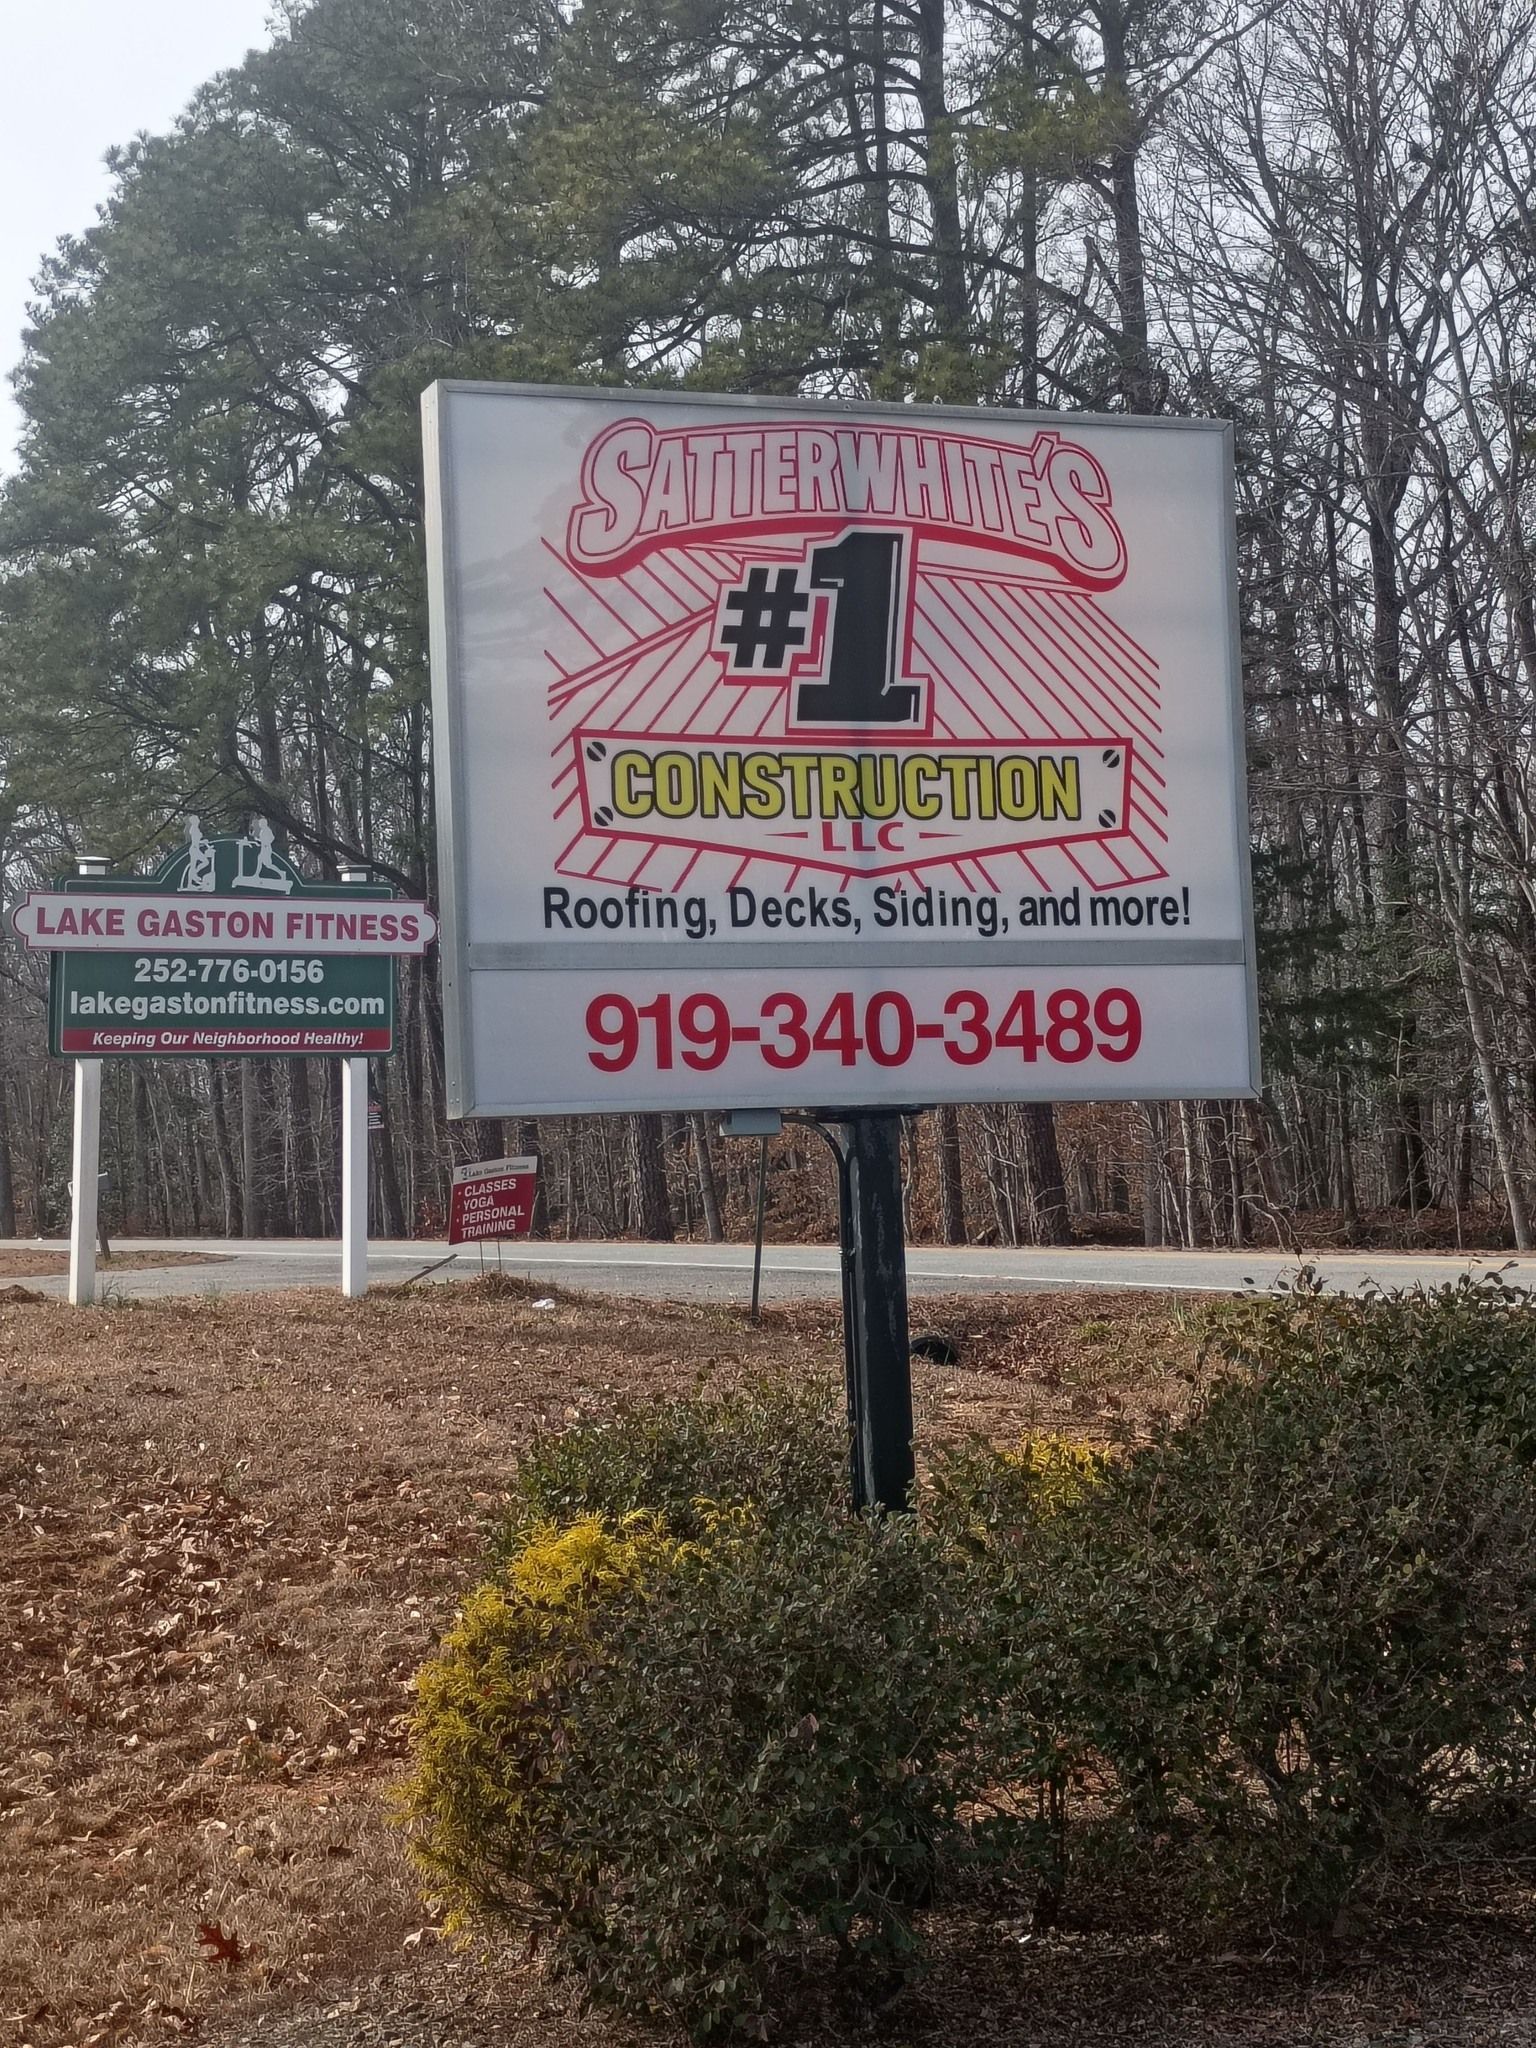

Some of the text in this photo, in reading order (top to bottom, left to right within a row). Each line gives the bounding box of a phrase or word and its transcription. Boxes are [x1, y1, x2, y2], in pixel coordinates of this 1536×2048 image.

[570, 418, 1126, 586] SATTERWHITE'S
[718, 530, 923, 724] #1
[611, 751, 1082, 821] CONSTRUCTION
[821, 821, 905, 853] LLC
[36, 907, 420, 941] LAKE GASTON FITNESS
[543, 884, 1192, 939] Roofing, Decks, Siding, and more!
[134, 958, 325, 983] 252-776-0156
[69, 990, 386, 1021] lakegastonfitness.com
[92, 1031, 364, 1048] Keeping Our Neighborhood Healthy!
[584, 988, 1144, 1073] 919-340-3489
[465, 1178, 516, 1197] CLASSES
[462, 1205, 525, 1225] PERSONAL
[463, 1196, 494, 1211] YOGA
[461, 1220, 516, 1239] TRAINING
